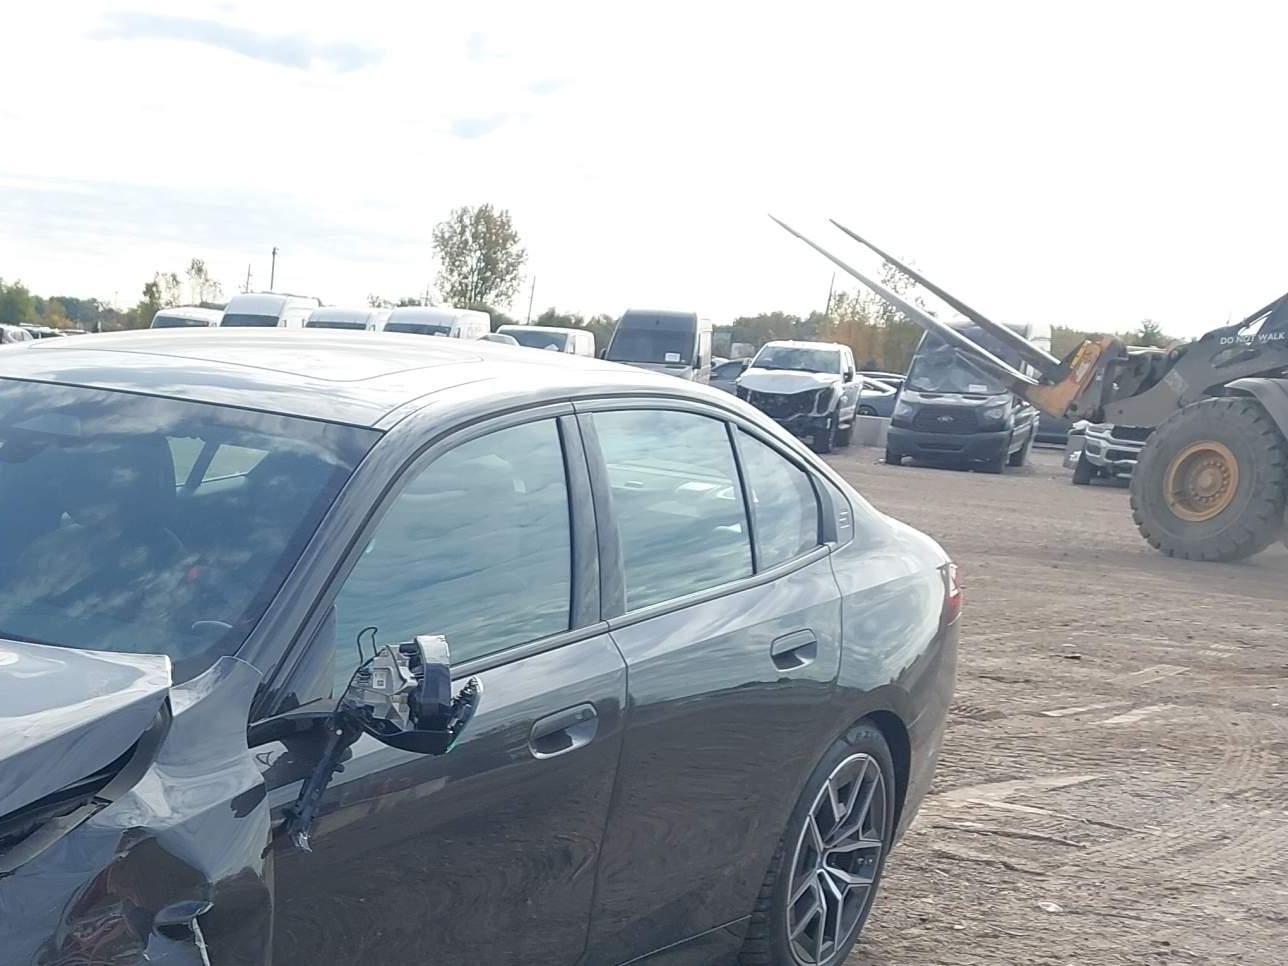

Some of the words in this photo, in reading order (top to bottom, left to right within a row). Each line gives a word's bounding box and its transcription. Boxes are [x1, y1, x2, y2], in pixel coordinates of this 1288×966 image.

[1220, 336, 1234, 345] DO
[1235, 334, 1255, 344] NOT
[1258, 331, 1286, 341] WALK
